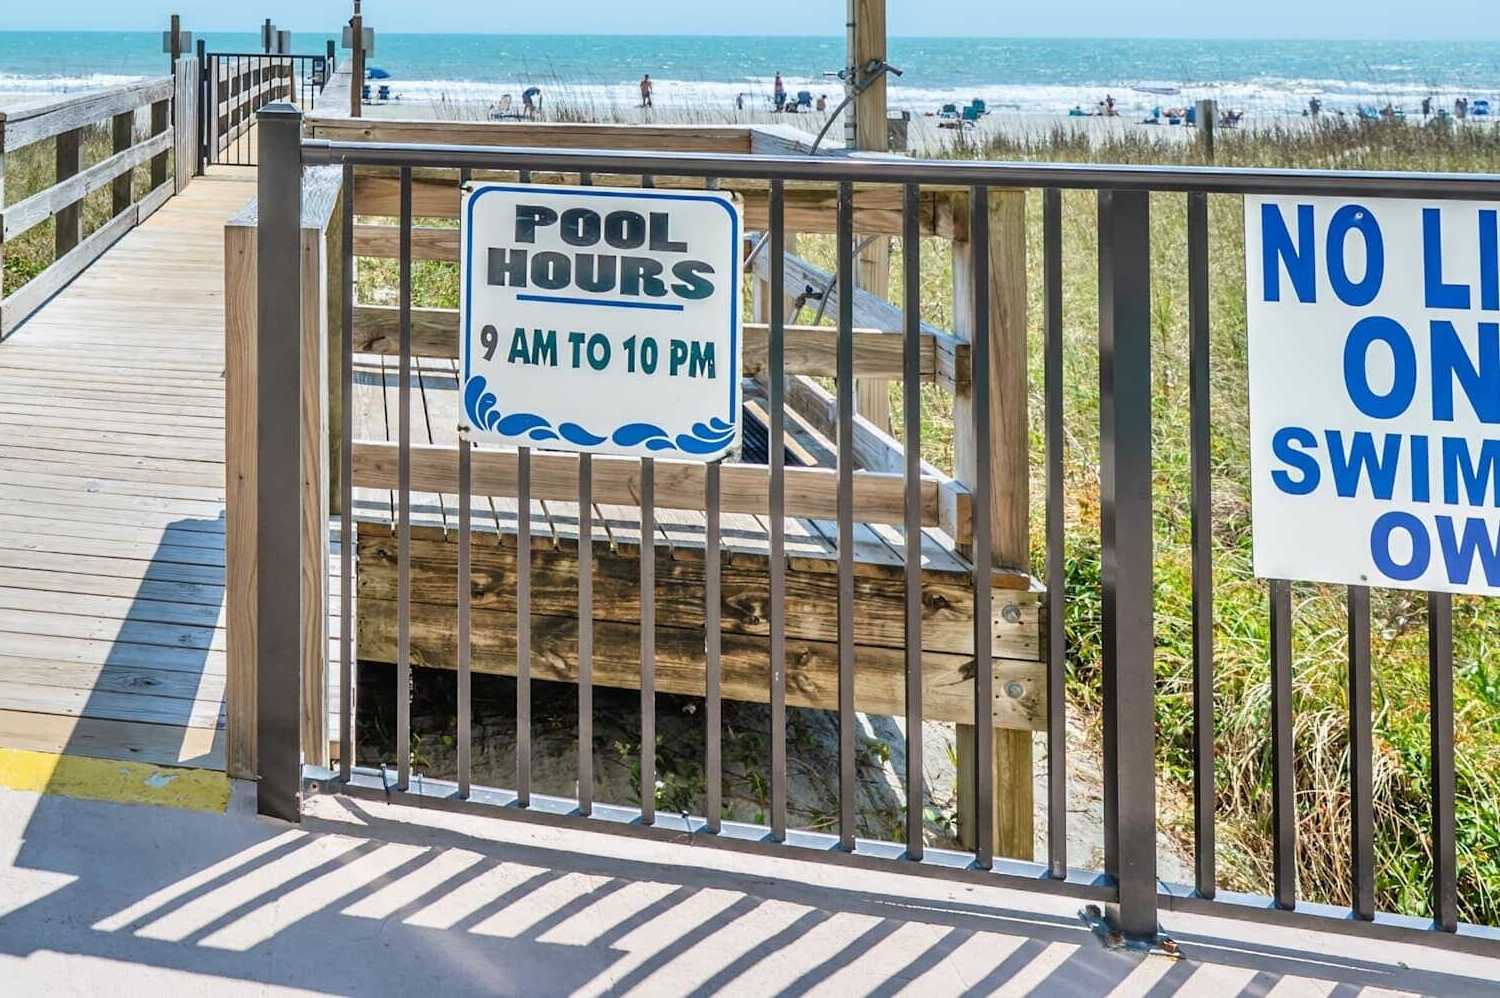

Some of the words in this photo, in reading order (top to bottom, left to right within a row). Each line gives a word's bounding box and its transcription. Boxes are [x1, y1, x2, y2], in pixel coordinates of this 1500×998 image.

[514, 204, 688, 253] POOL
[1260, 203, 1385, 307] NO
[1422, 208, 1500, 312] LI
[487, 247, 716, 300] HOURS
[480, 324, 499, 362] 9
[507, 327, 558, 367] AM
[567, 331, 612, 371] TO
[622, 334, 659, 375] 10
[669, 338, 716, 380] PM
[1343, 315, 1500, 425] ON
[1270, 426, 1500, 508] SWIM
